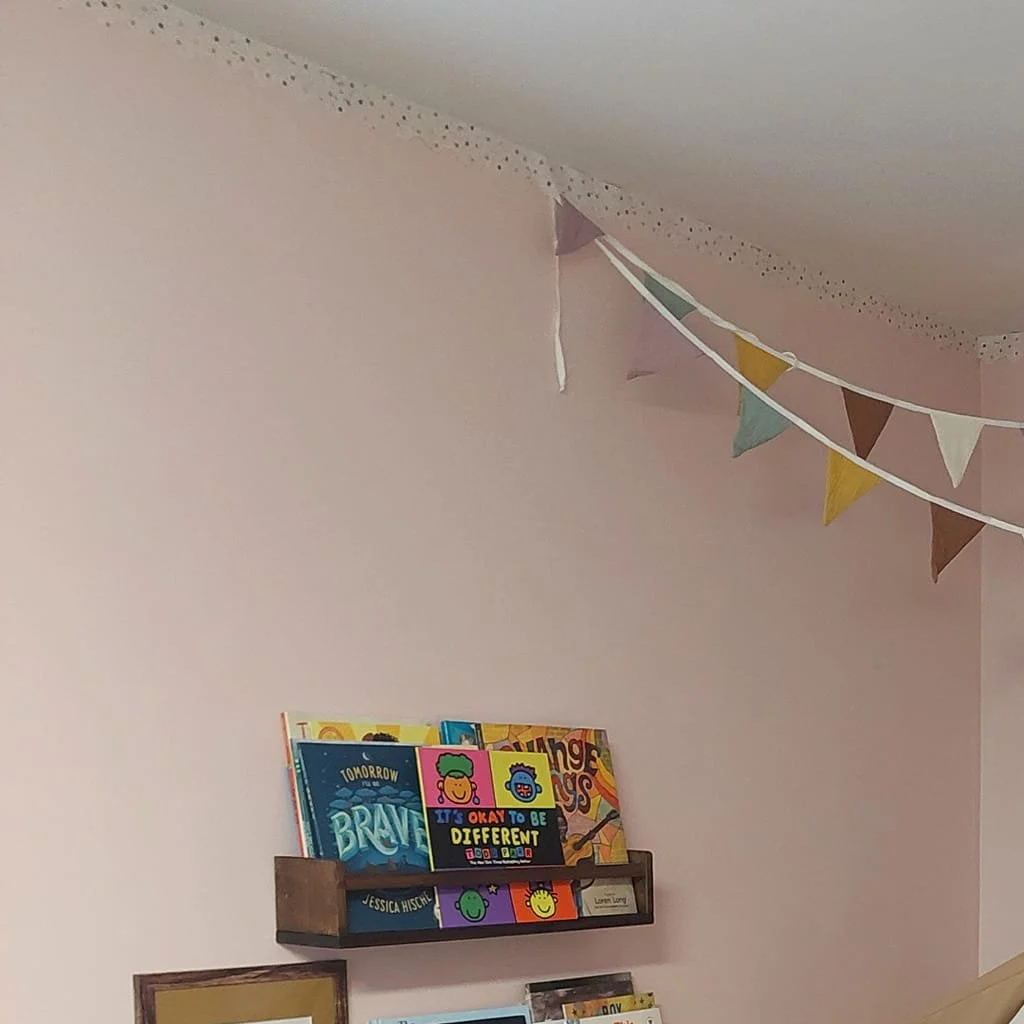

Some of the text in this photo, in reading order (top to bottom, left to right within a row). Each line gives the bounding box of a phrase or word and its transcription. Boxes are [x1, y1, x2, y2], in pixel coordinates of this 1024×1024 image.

[340, 764, 400, 783] TOMORROW
[435, 809, 546, 826] IT'S OKAY TO BE
[330, 803, 429, 862] BRAVE
[450, 827, 539, 847] DIFFERENT
[362, 893, 400, 913] JESSICA
